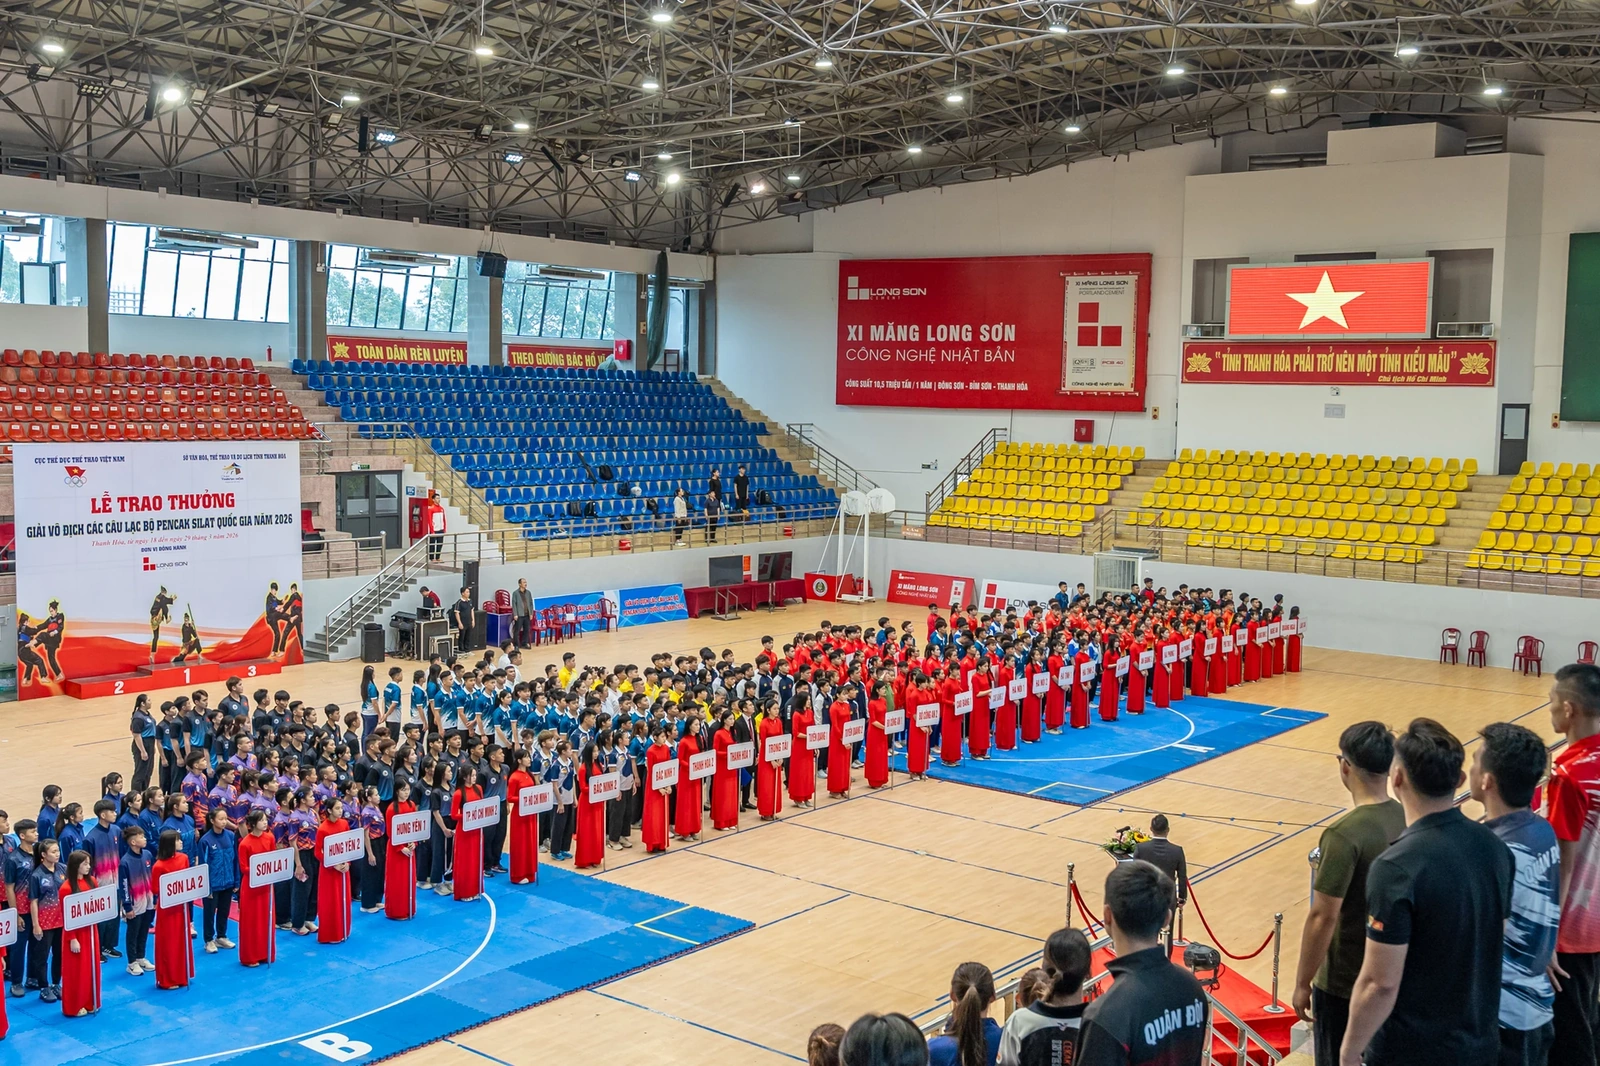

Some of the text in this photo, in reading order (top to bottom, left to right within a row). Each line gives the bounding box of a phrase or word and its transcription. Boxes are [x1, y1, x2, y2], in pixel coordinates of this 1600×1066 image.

[870, 288, 900, 296] LONG
[847, 322, 1015, 342] XI MĂNG LONG SƠN
[356, 343, 464, 365] TOÀN DÂN RÈN LUYỆN
[511, 352, 534, 365] THEO
[566, 352, 583, 367] BÁC
[585, 351, 596, 367] HỒ
[846, 346, 1015, 364] CÔNG NGHỆ NHẬT BẢN
[1243, 346, 1425, 376] THANH HÓA PHẢI TRỞ NÊN MỘT TỈNH KIỂU
[845, 379, 859, 388] CÔNG
[874, 381, 885, 389] 10,5
[1017, 381, 1028, 391] HÓA
[1378, 374, 1391, 382] Chủ
[35, 457, 45, 465] CỤC
[60, 457, 71, 465] DỤC
[72, 455, 83, 463] THỂ
[100, 455, 111, 464] VIỆT
[91, 489, 235, 514] LỄ TRAO THƯỞNG
[27, 513, 293, 538] GIẢI VÔ ĐỊCH CÁC CÂU LẠC BỘ PENCAK SILAT QUỐC GIA NĂM 2026
[184, 668, 191, 684] 1
[247, 665, 257, 677] 3
[114, 681, 124, 694] 2
[730, 751, 741, 762] THANH
[693, 761, 704, 772] THANH
[603, 780, 613, 793] NINH
[615, 780, 617, 790] 2
[529, 792, 533, 806] HỒ
[539, 792, 547, 804] MINH
[472, 806, 477, 820] HỒ
[485, 805, 494, 817] MINH
[495, 805, 498, 816] 2
[397, 819, 426, 835] HƯNG YÊN 1
[329, 838, 360, 857] HƯNG YÊN 2
[256, 858, 288, 877] SƠN LA 1
[167, 875, 203, 897] SƠN LA 2
[71, 896, 111, 919] ĐÀ NẴNG 1
[5, 921, 11, 934] 2
[1143, 999, 1204, 1046] QUÂN ĐỘI
[298, 1032, 373, 1063] B
